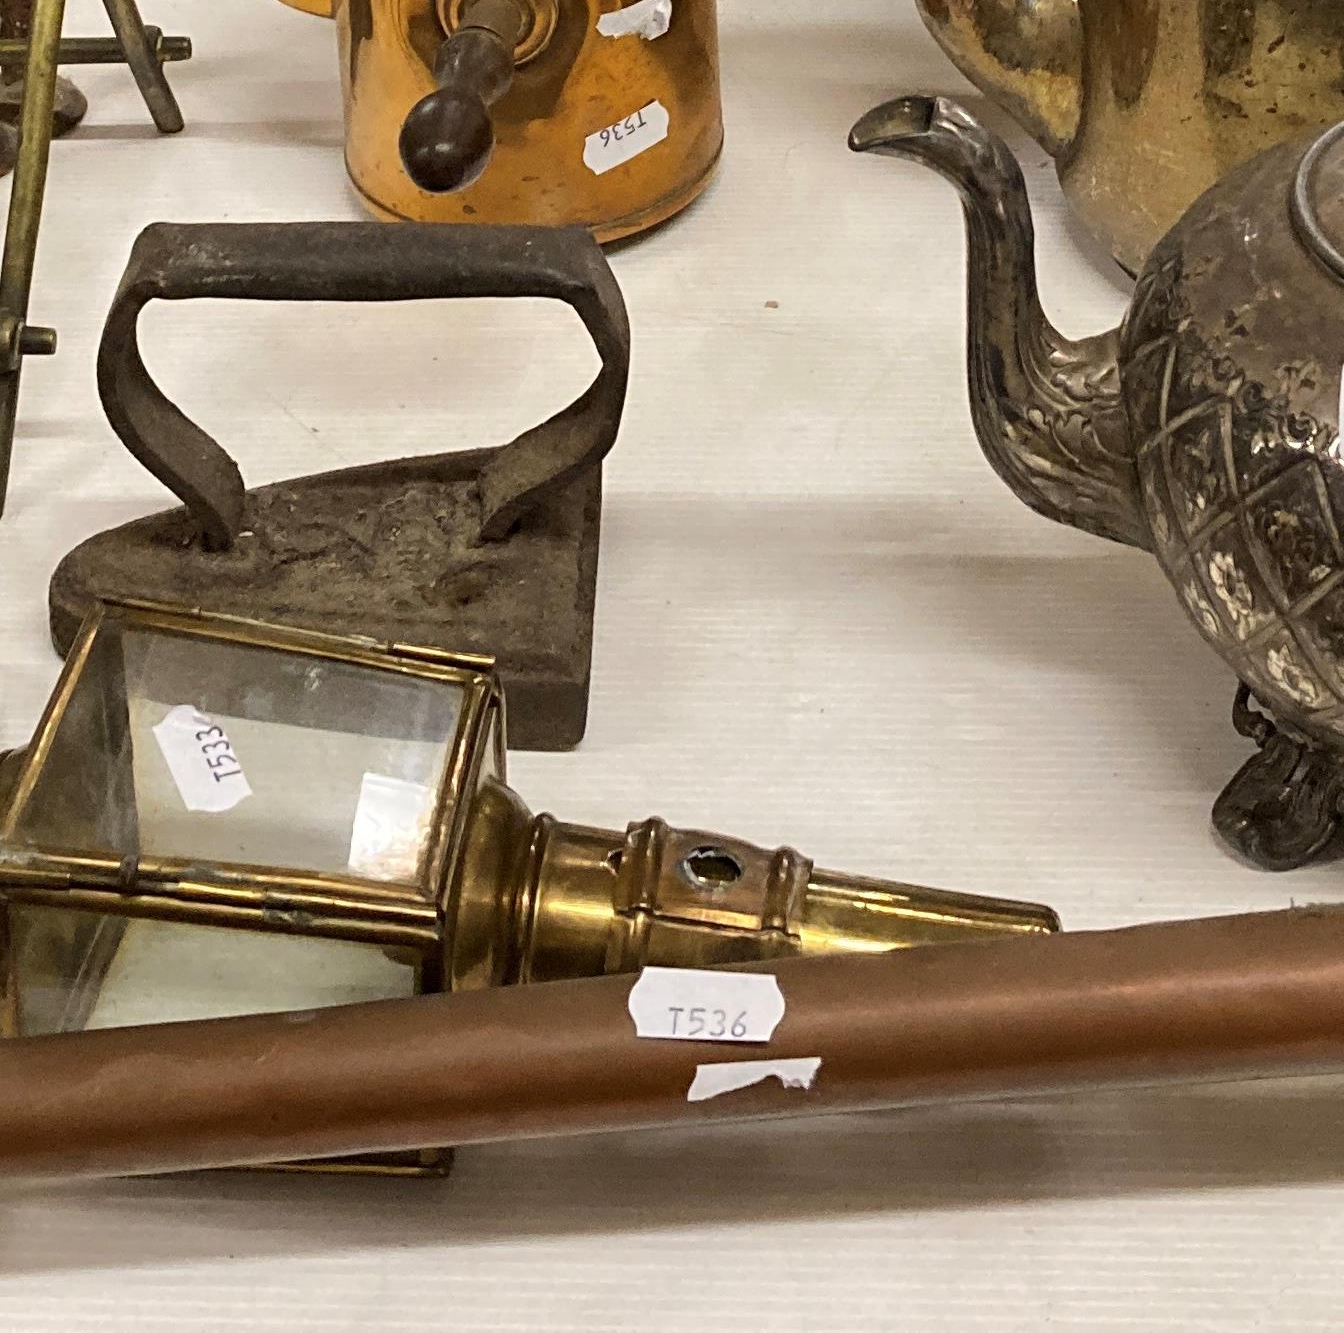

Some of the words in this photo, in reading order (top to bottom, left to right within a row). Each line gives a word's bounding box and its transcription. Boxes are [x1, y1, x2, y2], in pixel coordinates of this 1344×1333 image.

[599, 110, 647, 148] T536
[195, 726, 241, 782] T533
[668, 1007, 747, 1038] T536
